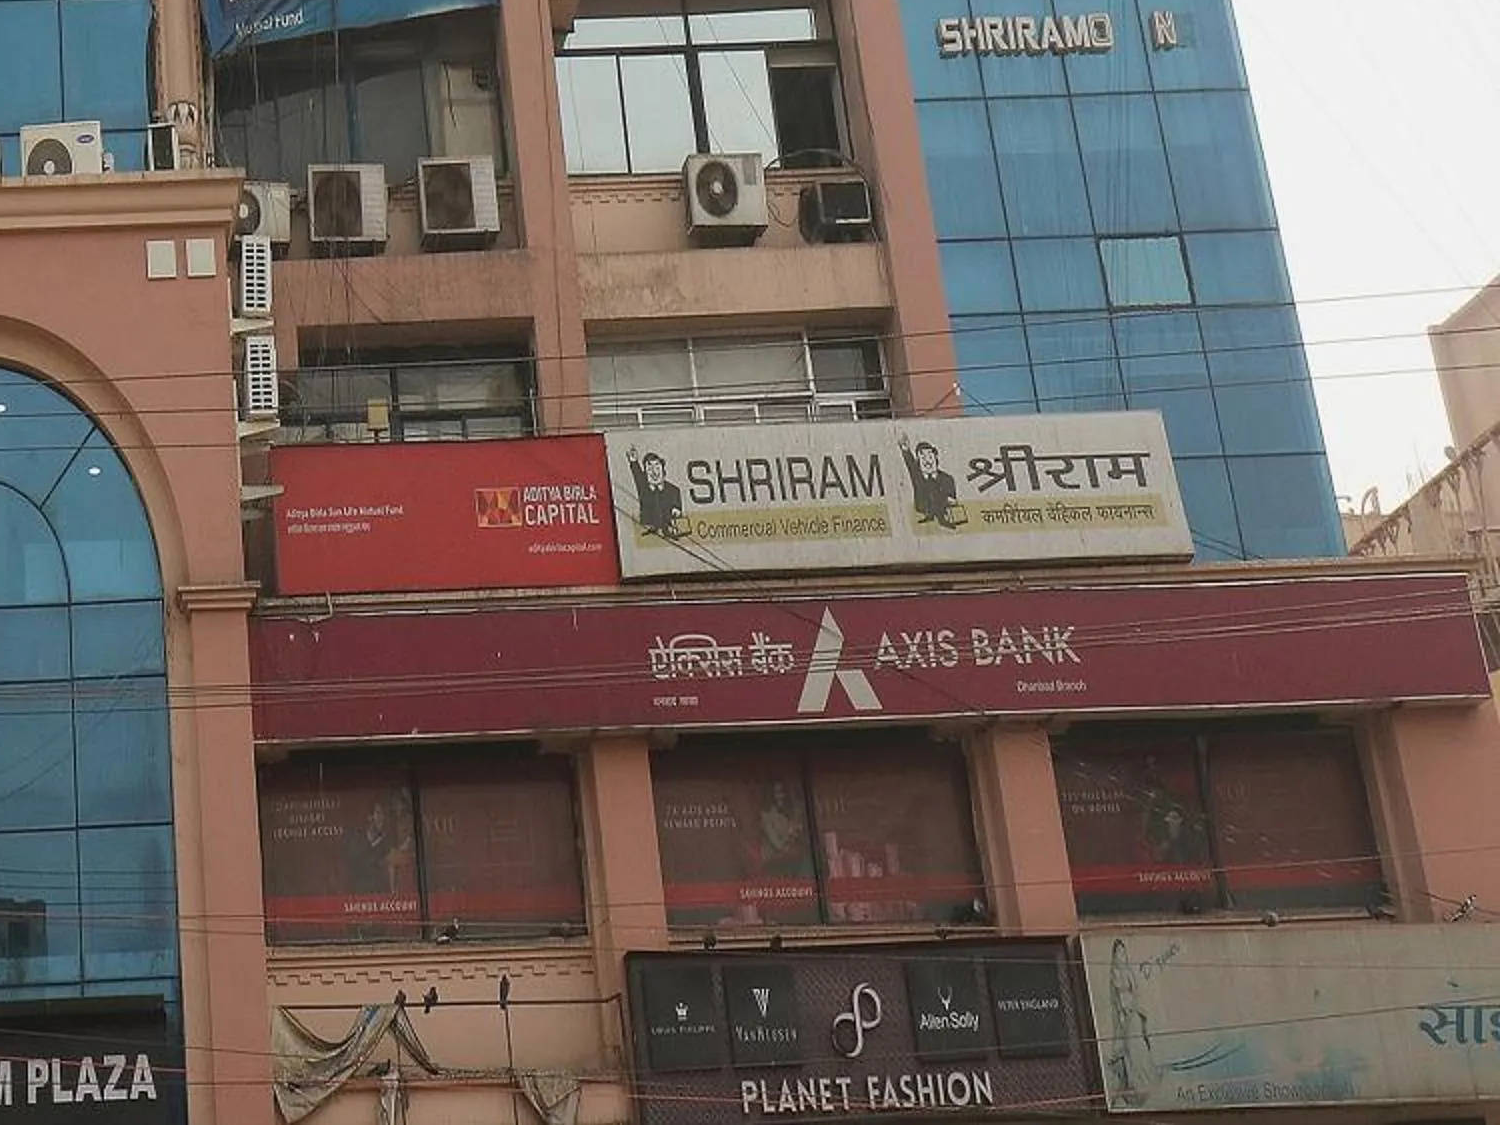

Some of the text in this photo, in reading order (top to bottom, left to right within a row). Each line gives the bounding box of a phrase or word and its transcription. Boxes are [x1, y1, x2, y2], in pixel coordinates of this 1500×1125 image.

[688, 453, 885, 505] SHRIRAM
[967, 444, 1150, 493] श्रीराम
[524, 484, 597, 503] ADITYA BIRLA
[525, 503, 600, 526] CAPITAL
[697, 518, 776, 540] Commercial
[832, 514, 886, 534] Finance
[748, 632, 796, 674] बैंक
[874, 625, 1083, 670] AXIS BANK
[26, 1053, 157, 1105] PLAZA
[741, 1071, 994, 1114] PLANET FASHION
